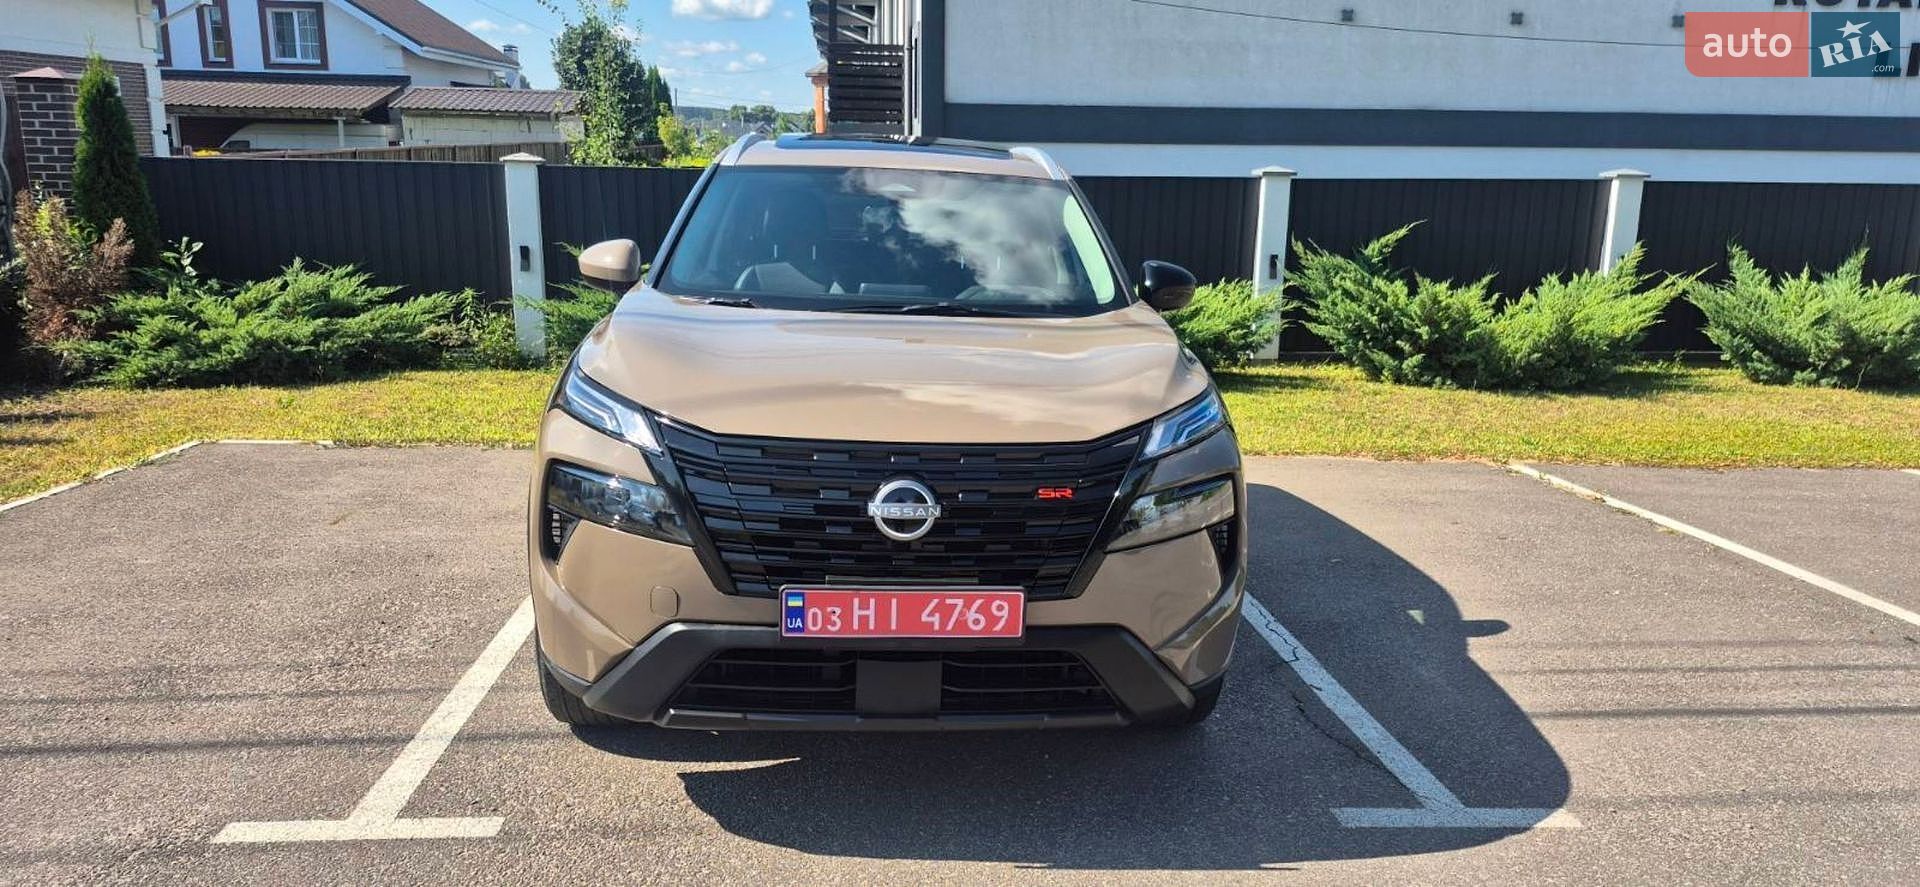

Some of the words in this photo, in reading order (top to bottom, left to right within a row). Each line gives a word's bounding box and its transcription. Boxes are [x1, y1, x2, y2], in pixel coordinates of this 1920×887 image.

[1038, 487, 1073, 499] SR
[869, 505, 940, 517] NISSAN
[807, 607, 842, 632] 03
[852, 597, 897, 631] HI
[920, 598, 1009, 632] 4769
[787, 617, 803, 629] UA
